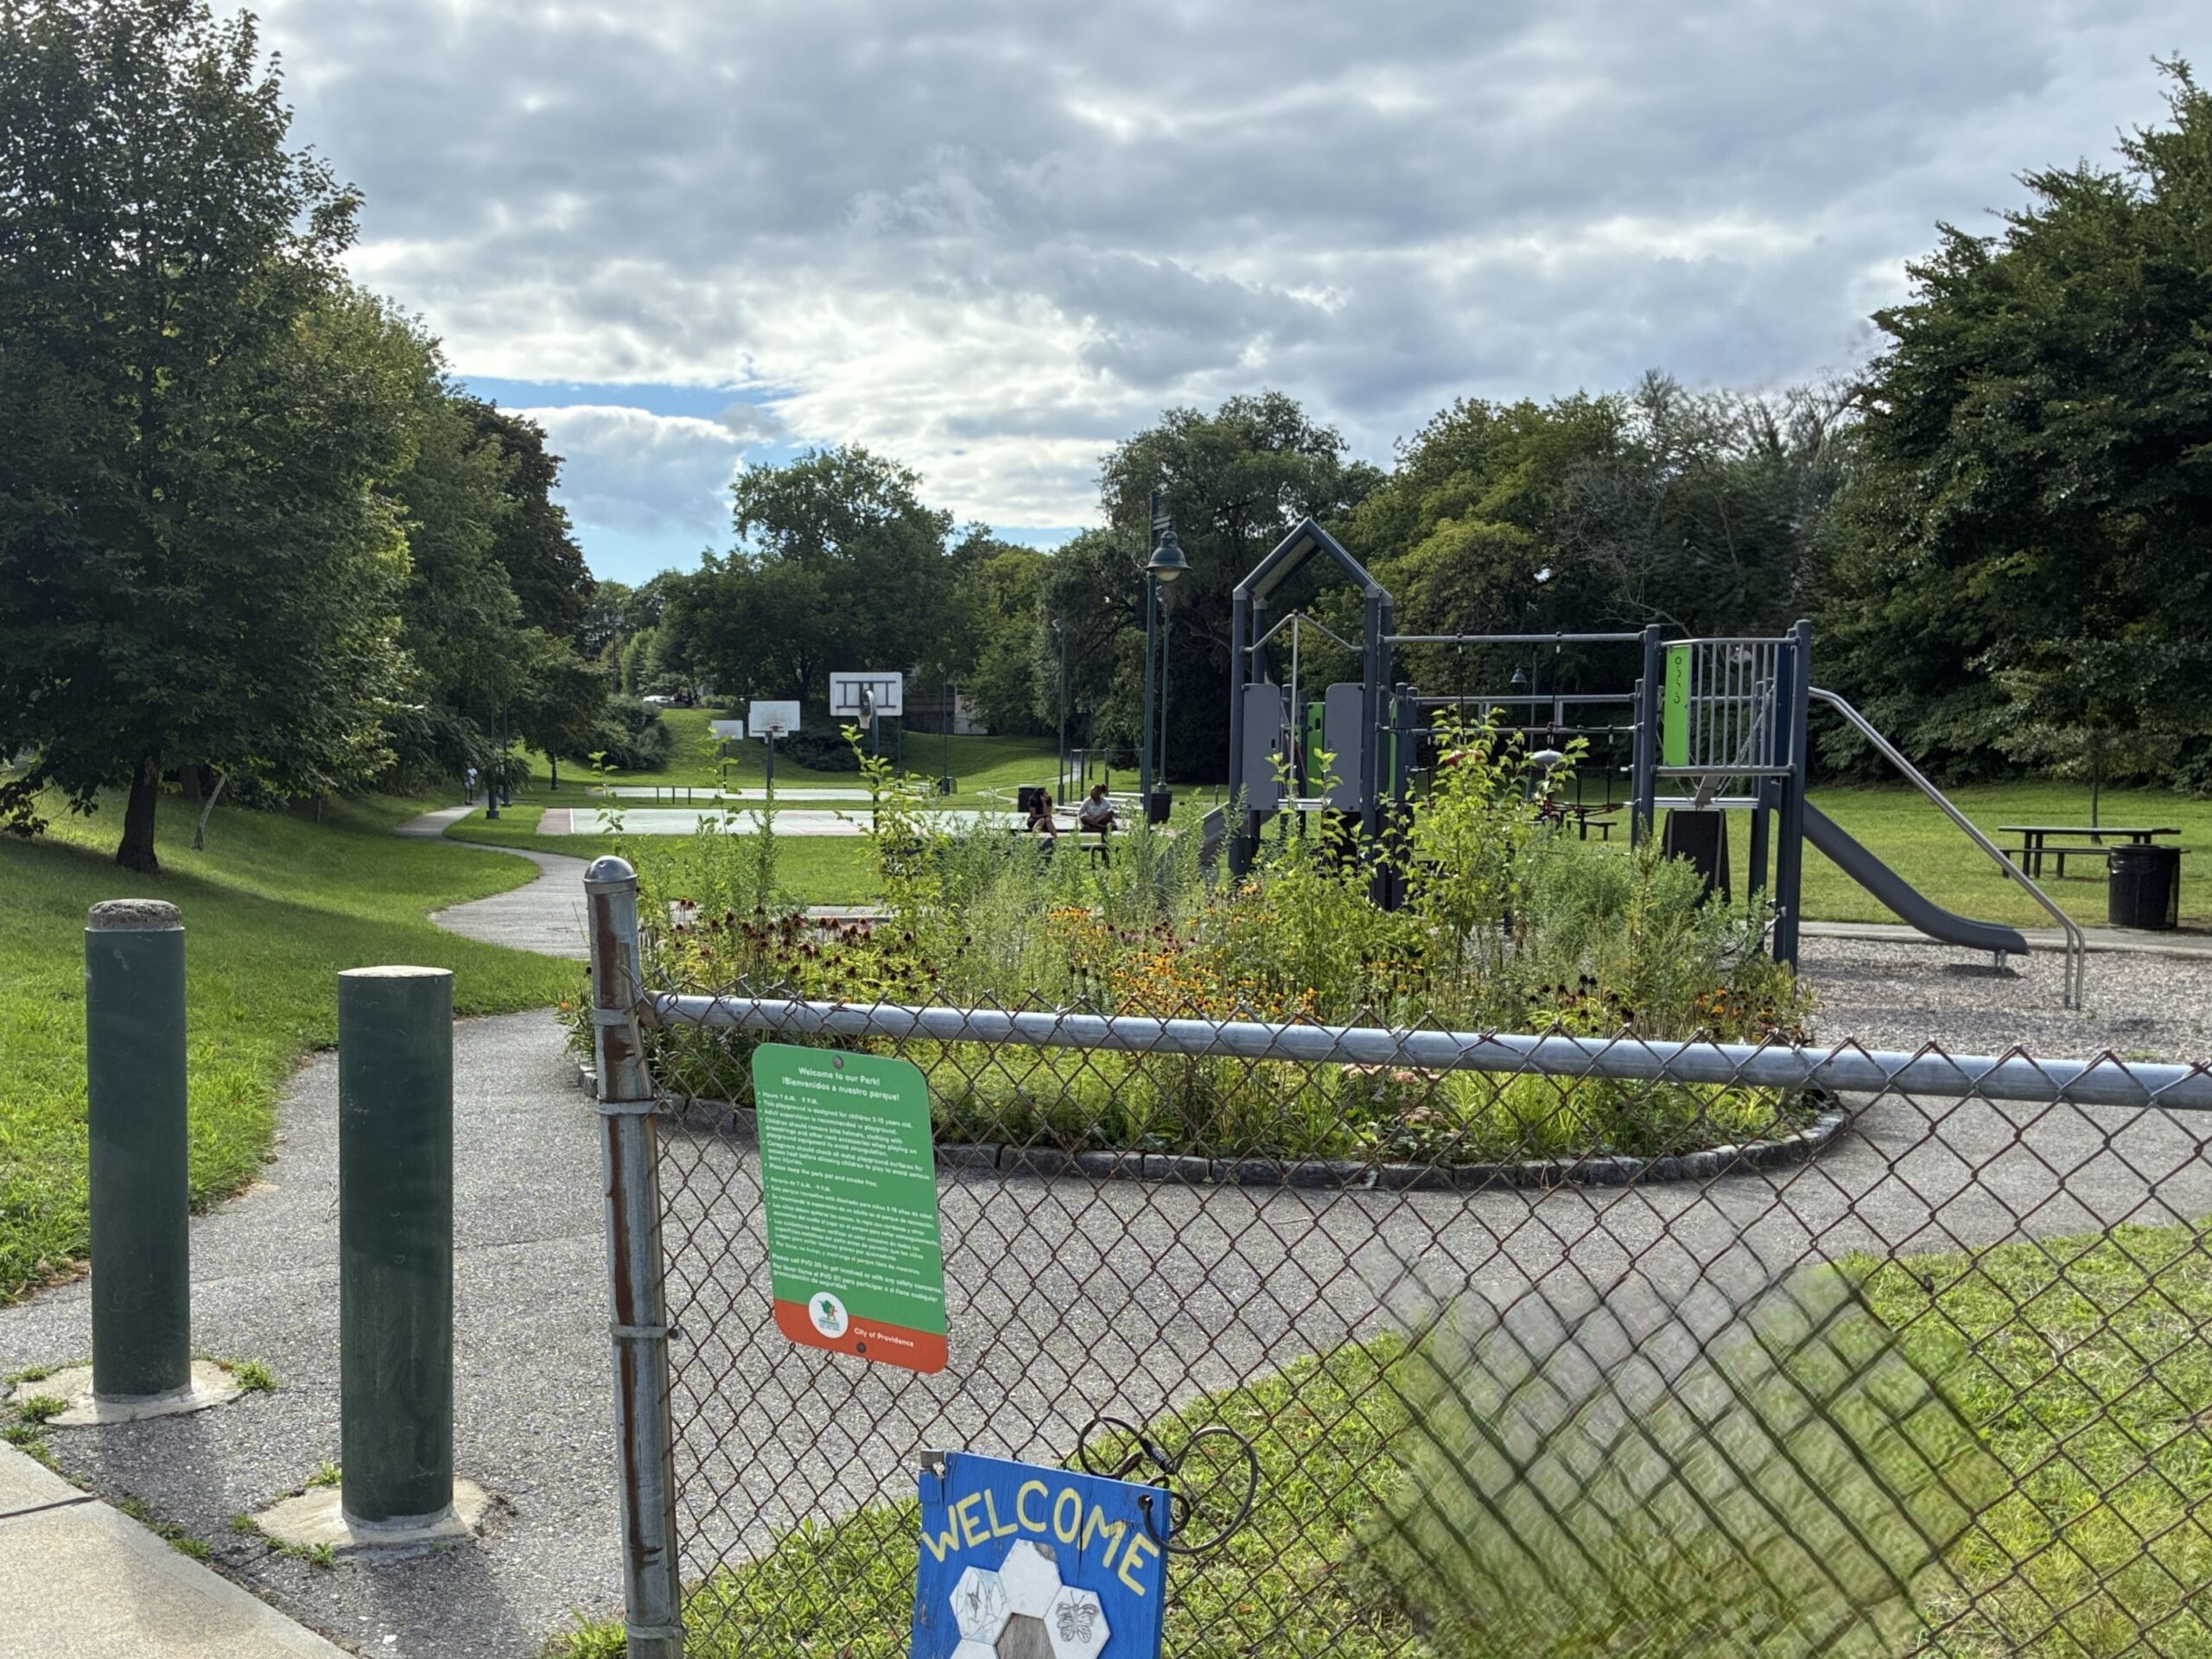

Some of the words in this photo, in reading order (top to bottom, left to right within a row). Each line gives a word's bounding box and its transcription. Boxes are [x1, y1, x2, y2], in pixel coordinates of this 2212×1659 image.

[798, 1066, 833, 1078] Welcome
[834, 1071, 843, 1080] to
[859, 1075, 880, 1085] Park!
[781, 1076, 830, 1090] ¡Bienvenidos
[838, 1085, 867, 1096] nuestro
[868, 1090, 899, 1101] parque!
[854, 1326, 867, 1337] City
[868, 1330, 875, 1338] of
[877, 1332, 914, 1347] Providence
[922, 1480, 1160, 1596] WELCOME
